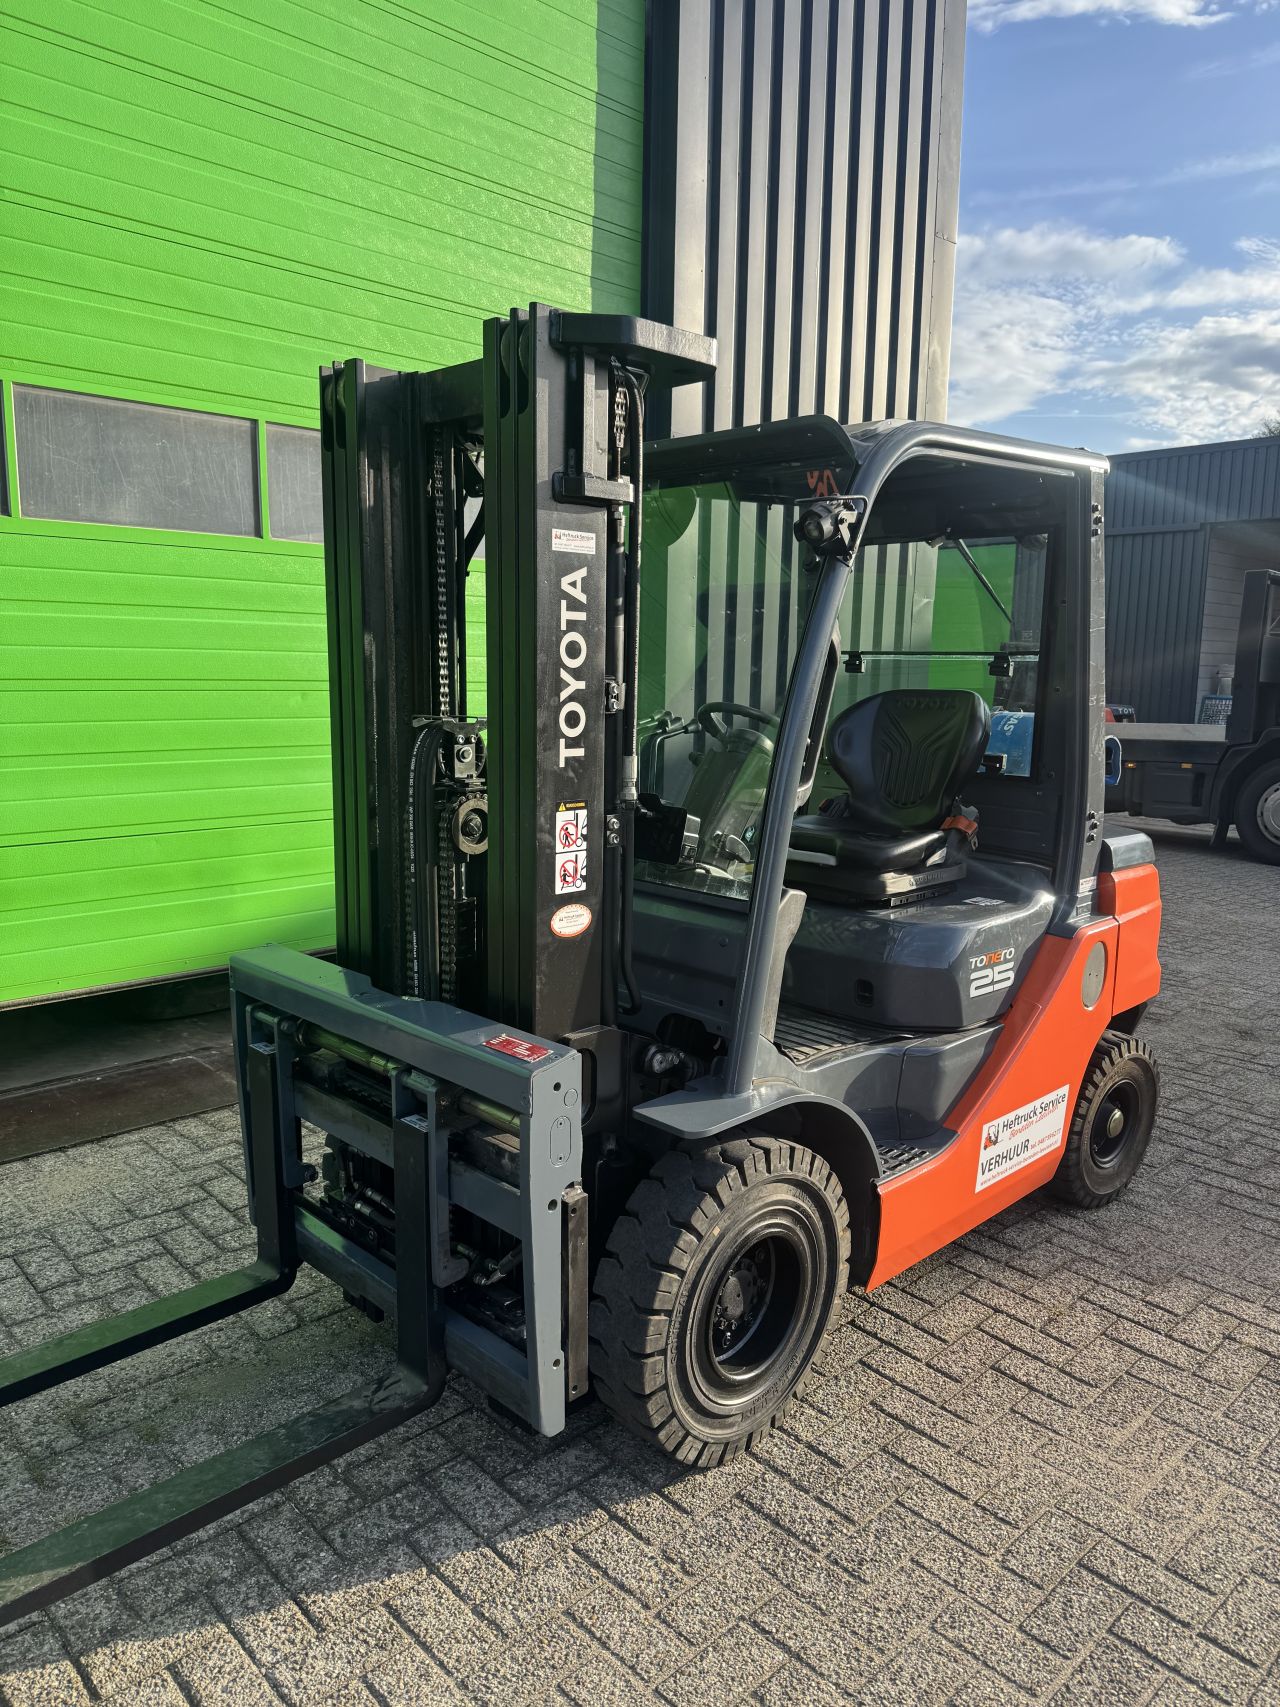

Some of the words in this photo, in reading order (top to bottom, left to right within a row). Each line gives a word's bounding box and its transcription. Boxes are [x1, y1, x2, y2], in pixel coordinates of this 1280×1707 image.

[559, 566, 588, 768] TOYOTA
[970, 961, 1015, 998] 25
[1002, 1105, 1038, 1133] Heftruck
[1039, 1093, 1067, 1115] Service
[980, 1138, 1030, 1176] VERHUUR
